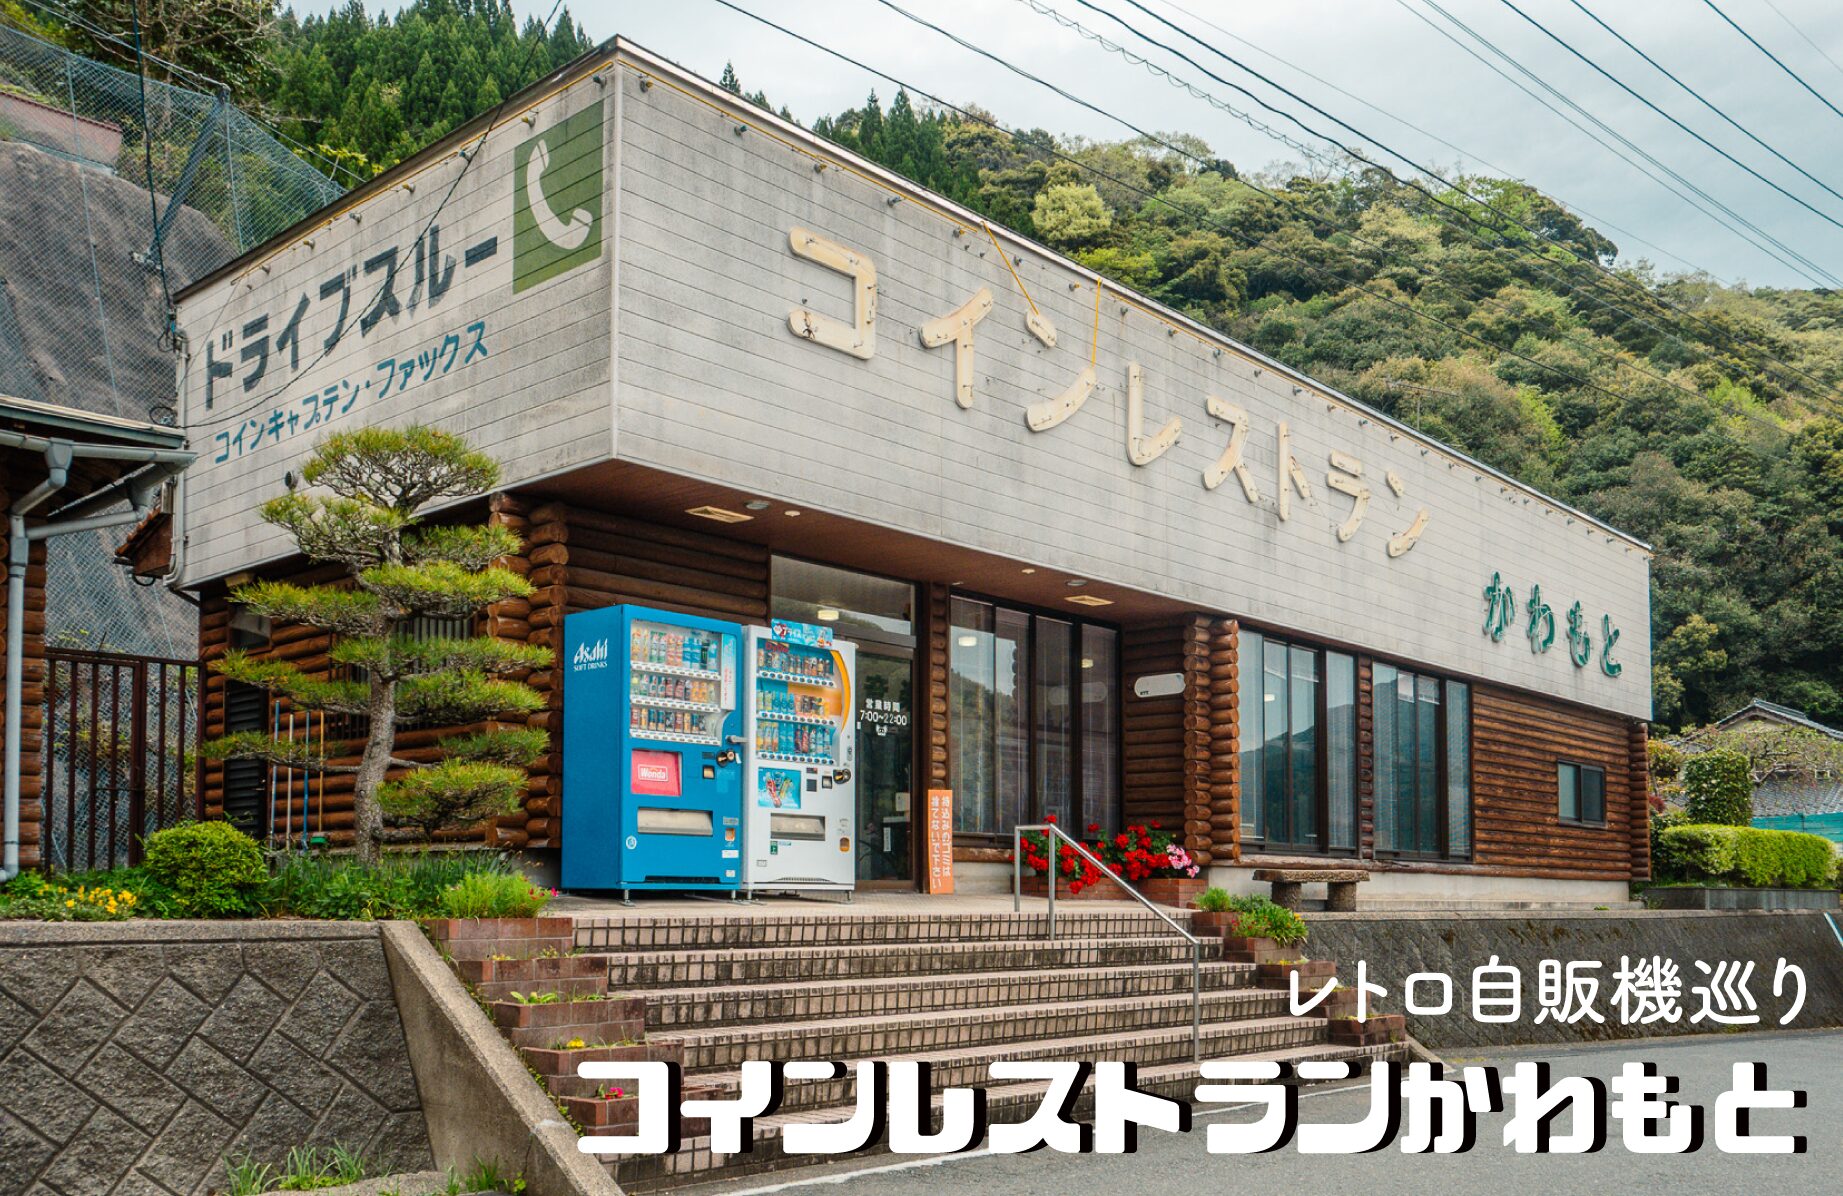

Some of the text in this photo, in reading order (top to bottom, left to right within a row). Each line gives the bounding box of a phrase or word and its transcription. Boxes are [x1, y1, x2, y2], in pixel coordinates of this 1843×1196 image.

[205, 224, 498, 411] ドライブスルー
[215, 320, 489, 464] コインキャプテン・ファックス
[787, 226, 1430, 559] コインレストラン
[573, 638, 608, 664] Asahi
[1483, 571, 1623, 678] かわもと
[865, 698, 901, 713] 営業時間
[640, 766, 667, 780] Wonda
